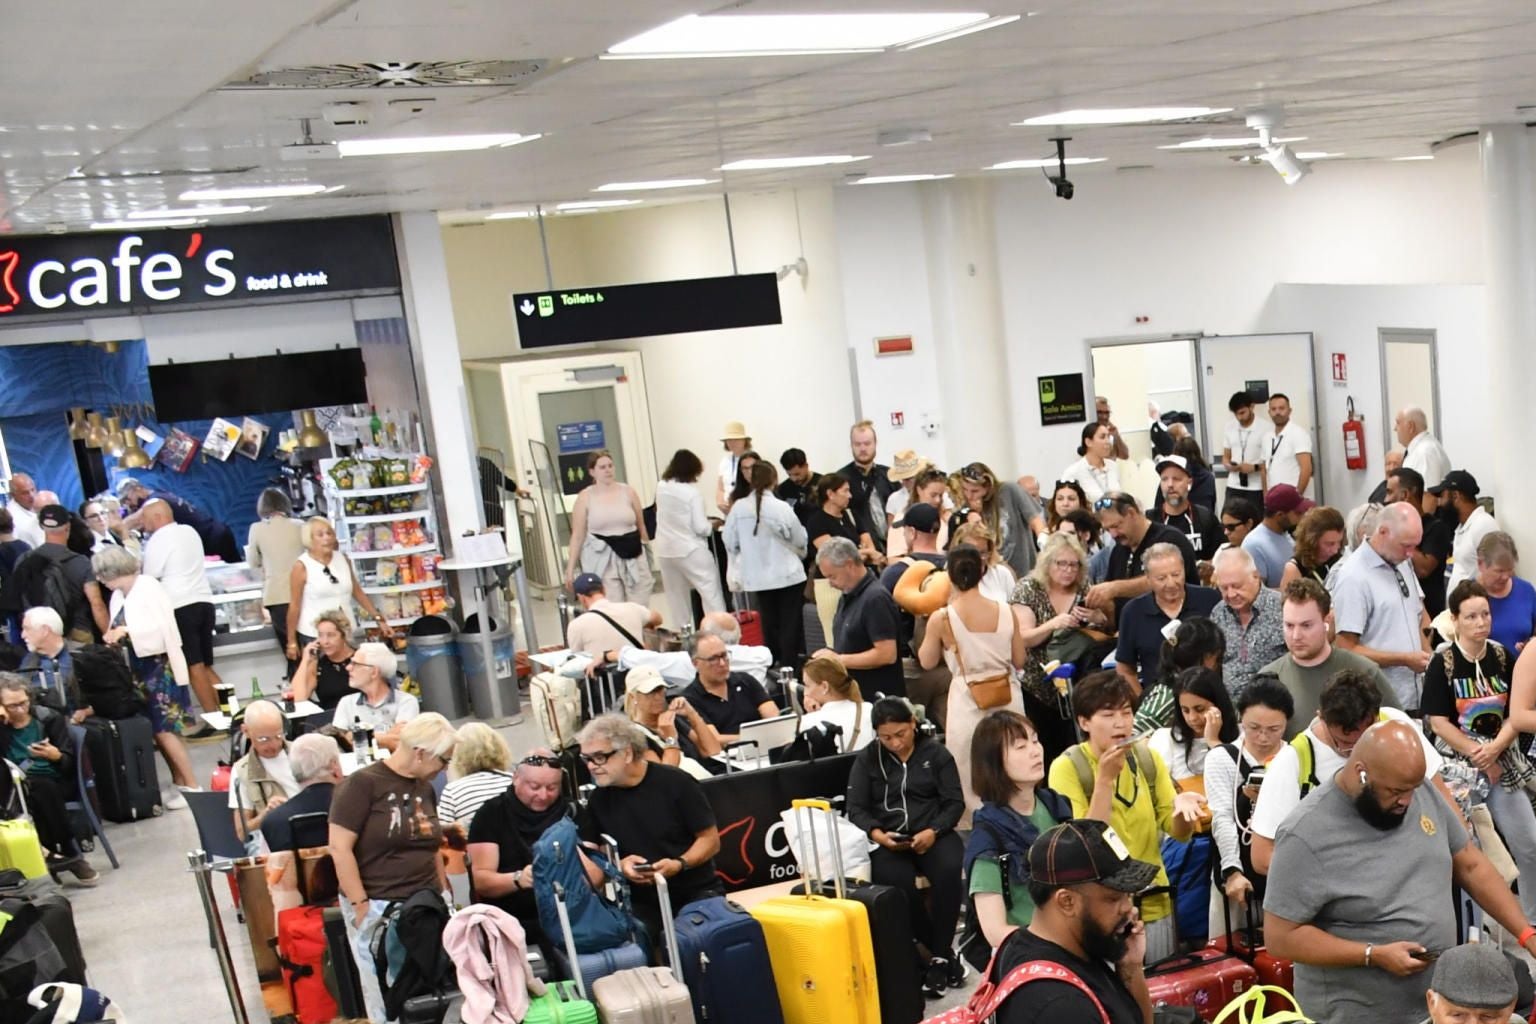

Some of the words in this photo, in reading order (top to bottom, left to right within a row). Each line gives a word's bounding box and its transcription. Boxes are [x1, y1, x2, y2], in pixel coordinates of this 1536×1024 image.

[247, 274, 278, 291] food
[280, 273, 292, 288] &
[293, 271, 328, 287] drink
[560, 293, 595, 306] Toilets
